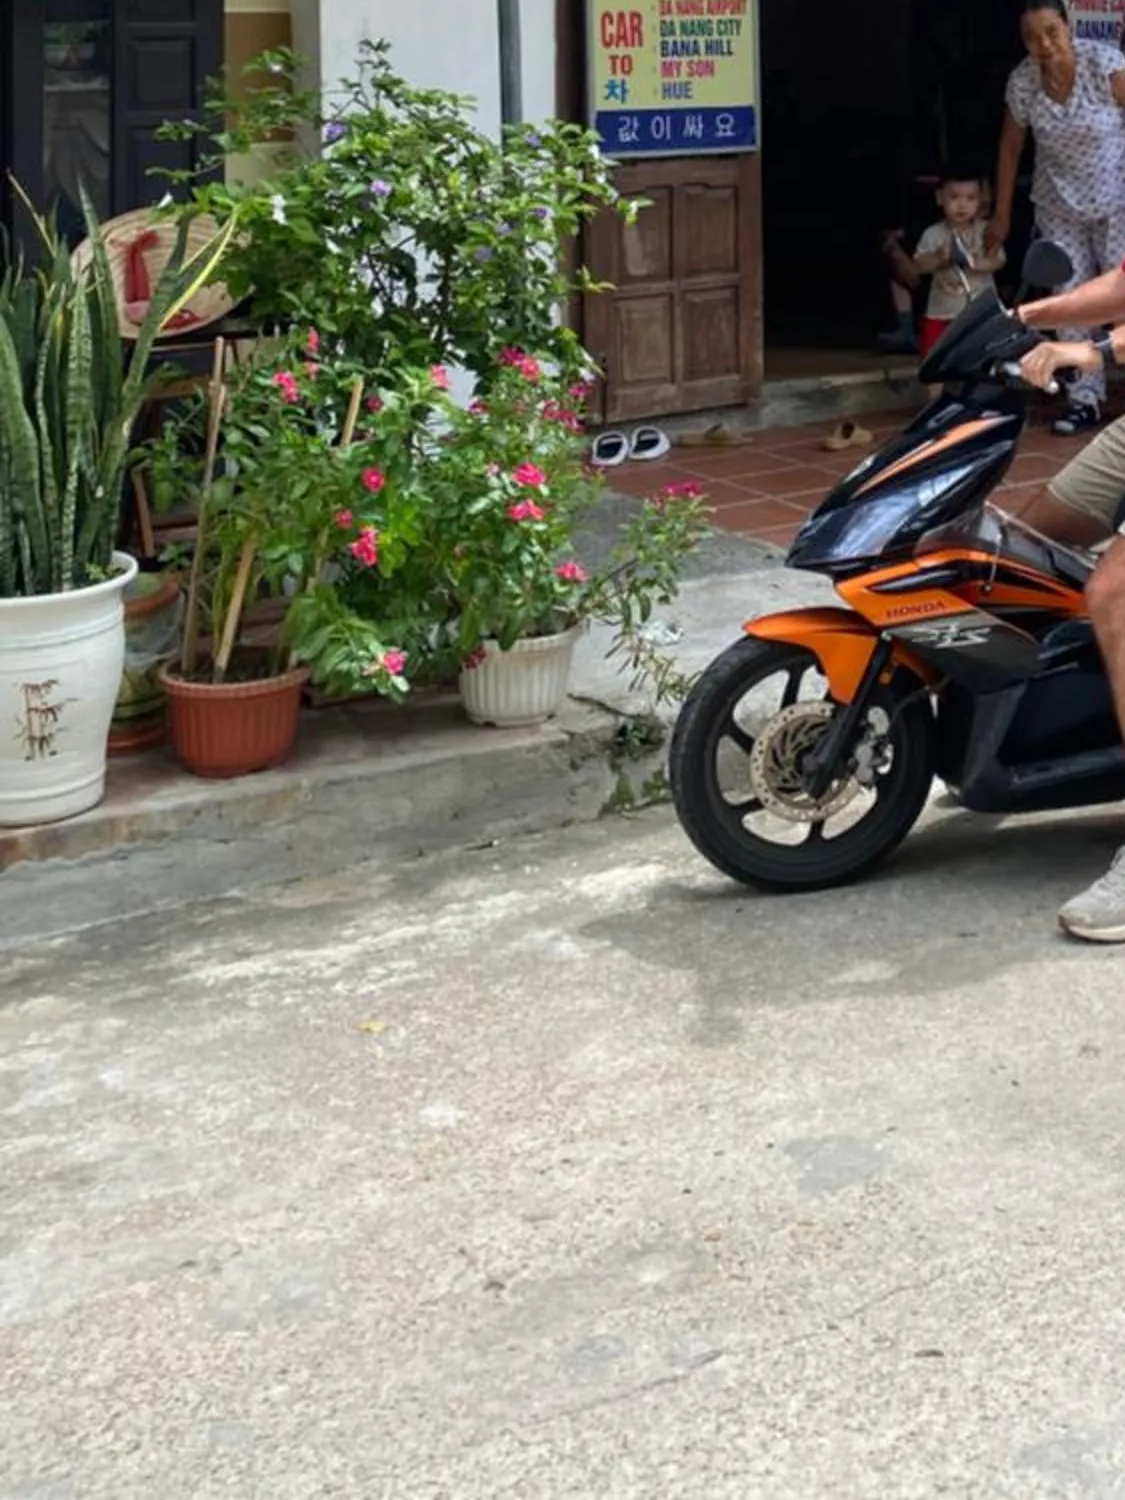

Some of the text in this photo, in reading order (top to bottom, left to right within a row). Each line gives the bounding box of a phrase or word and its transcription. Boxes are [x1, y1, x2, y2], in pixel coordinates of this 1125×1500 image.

[600, 10, 644, 49] CAR
[660, 17, 743, 37] DA NANG CITY
[660, 38, 734, 58] BANA HILL
[608, 54, 634, 77] TO
[660, 59, 716, 79] MY SON
[603, 78, 631, 104] 차
[660, 80, 693, 101] HUE
[885, 599, 946, 619] HONDA
